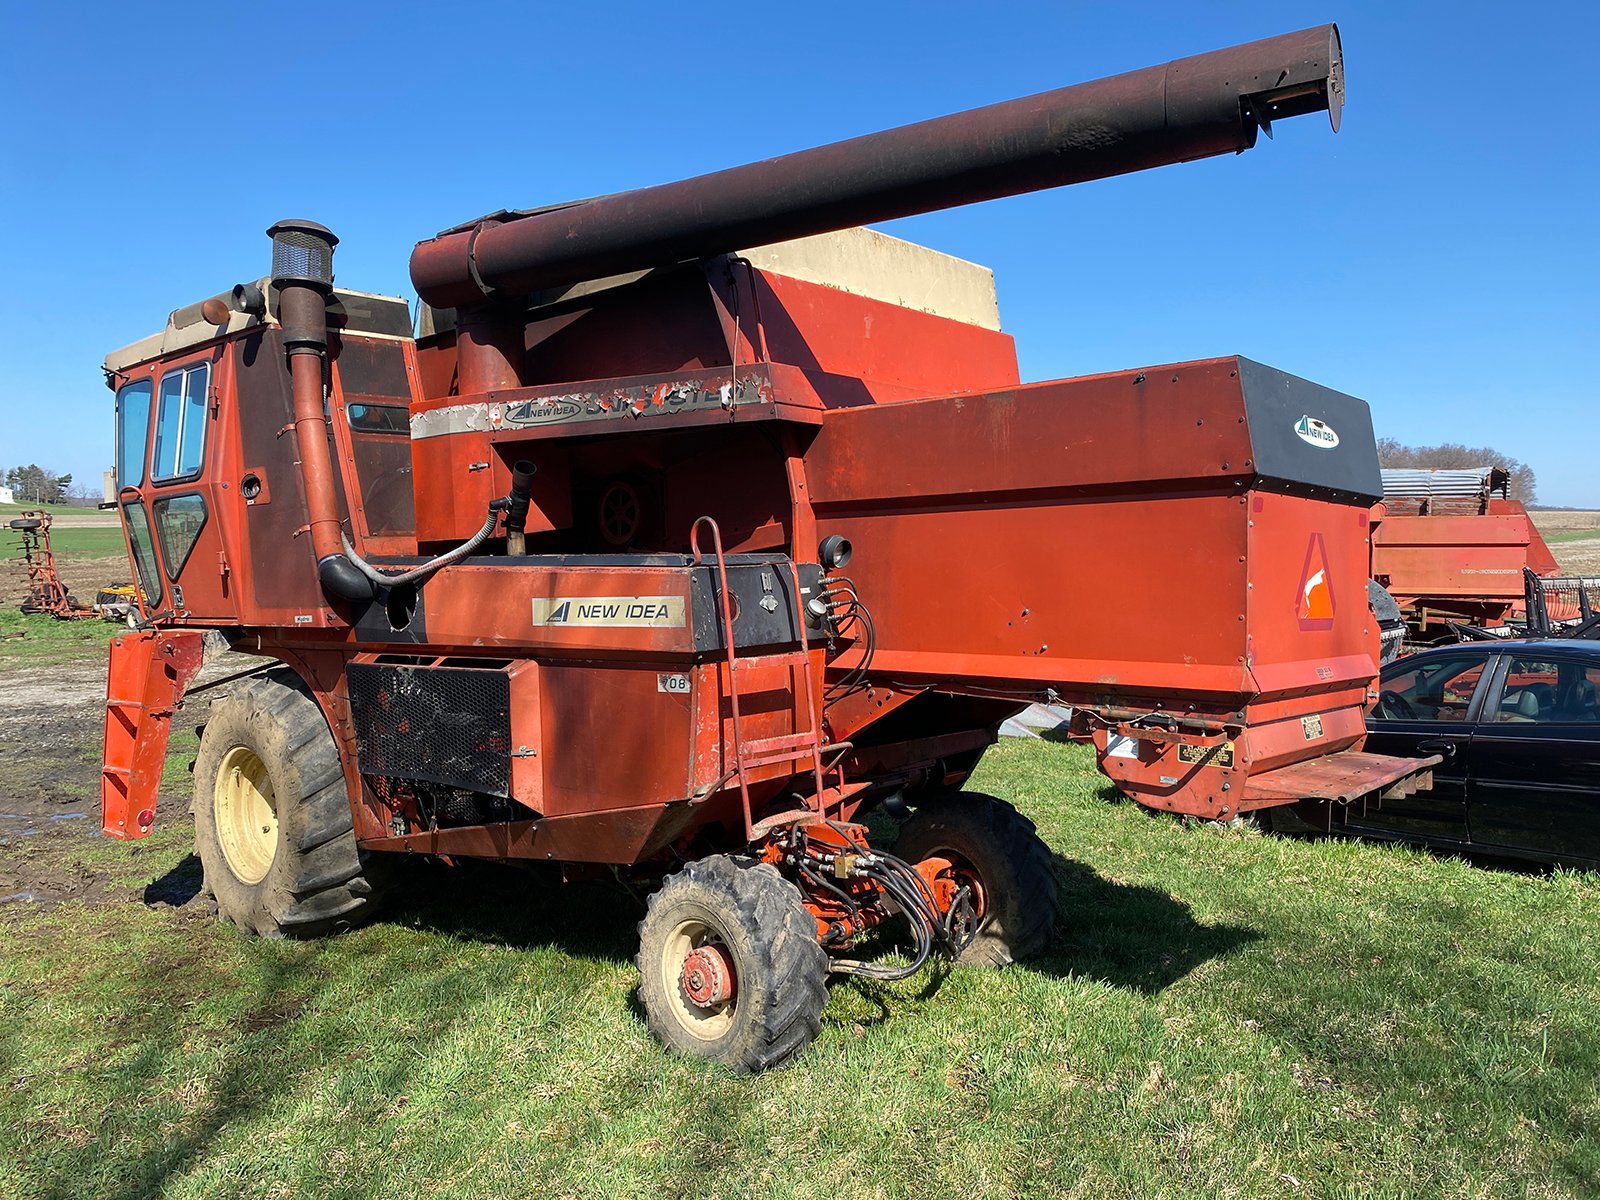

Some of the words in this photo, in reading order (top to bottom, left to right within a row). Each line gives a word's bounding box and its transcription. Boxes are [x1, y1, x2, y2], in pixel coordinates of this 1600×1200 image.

[530, 408, 553, 418] NEW
[553, 406, 575, 416] IDEA
[1309, 427, 1322, 439] NEW
[1322, 432, 1335, 443] IDEA
[577, 604, 620, 619] NEW
[625, 604, 669, 619] IDEA
